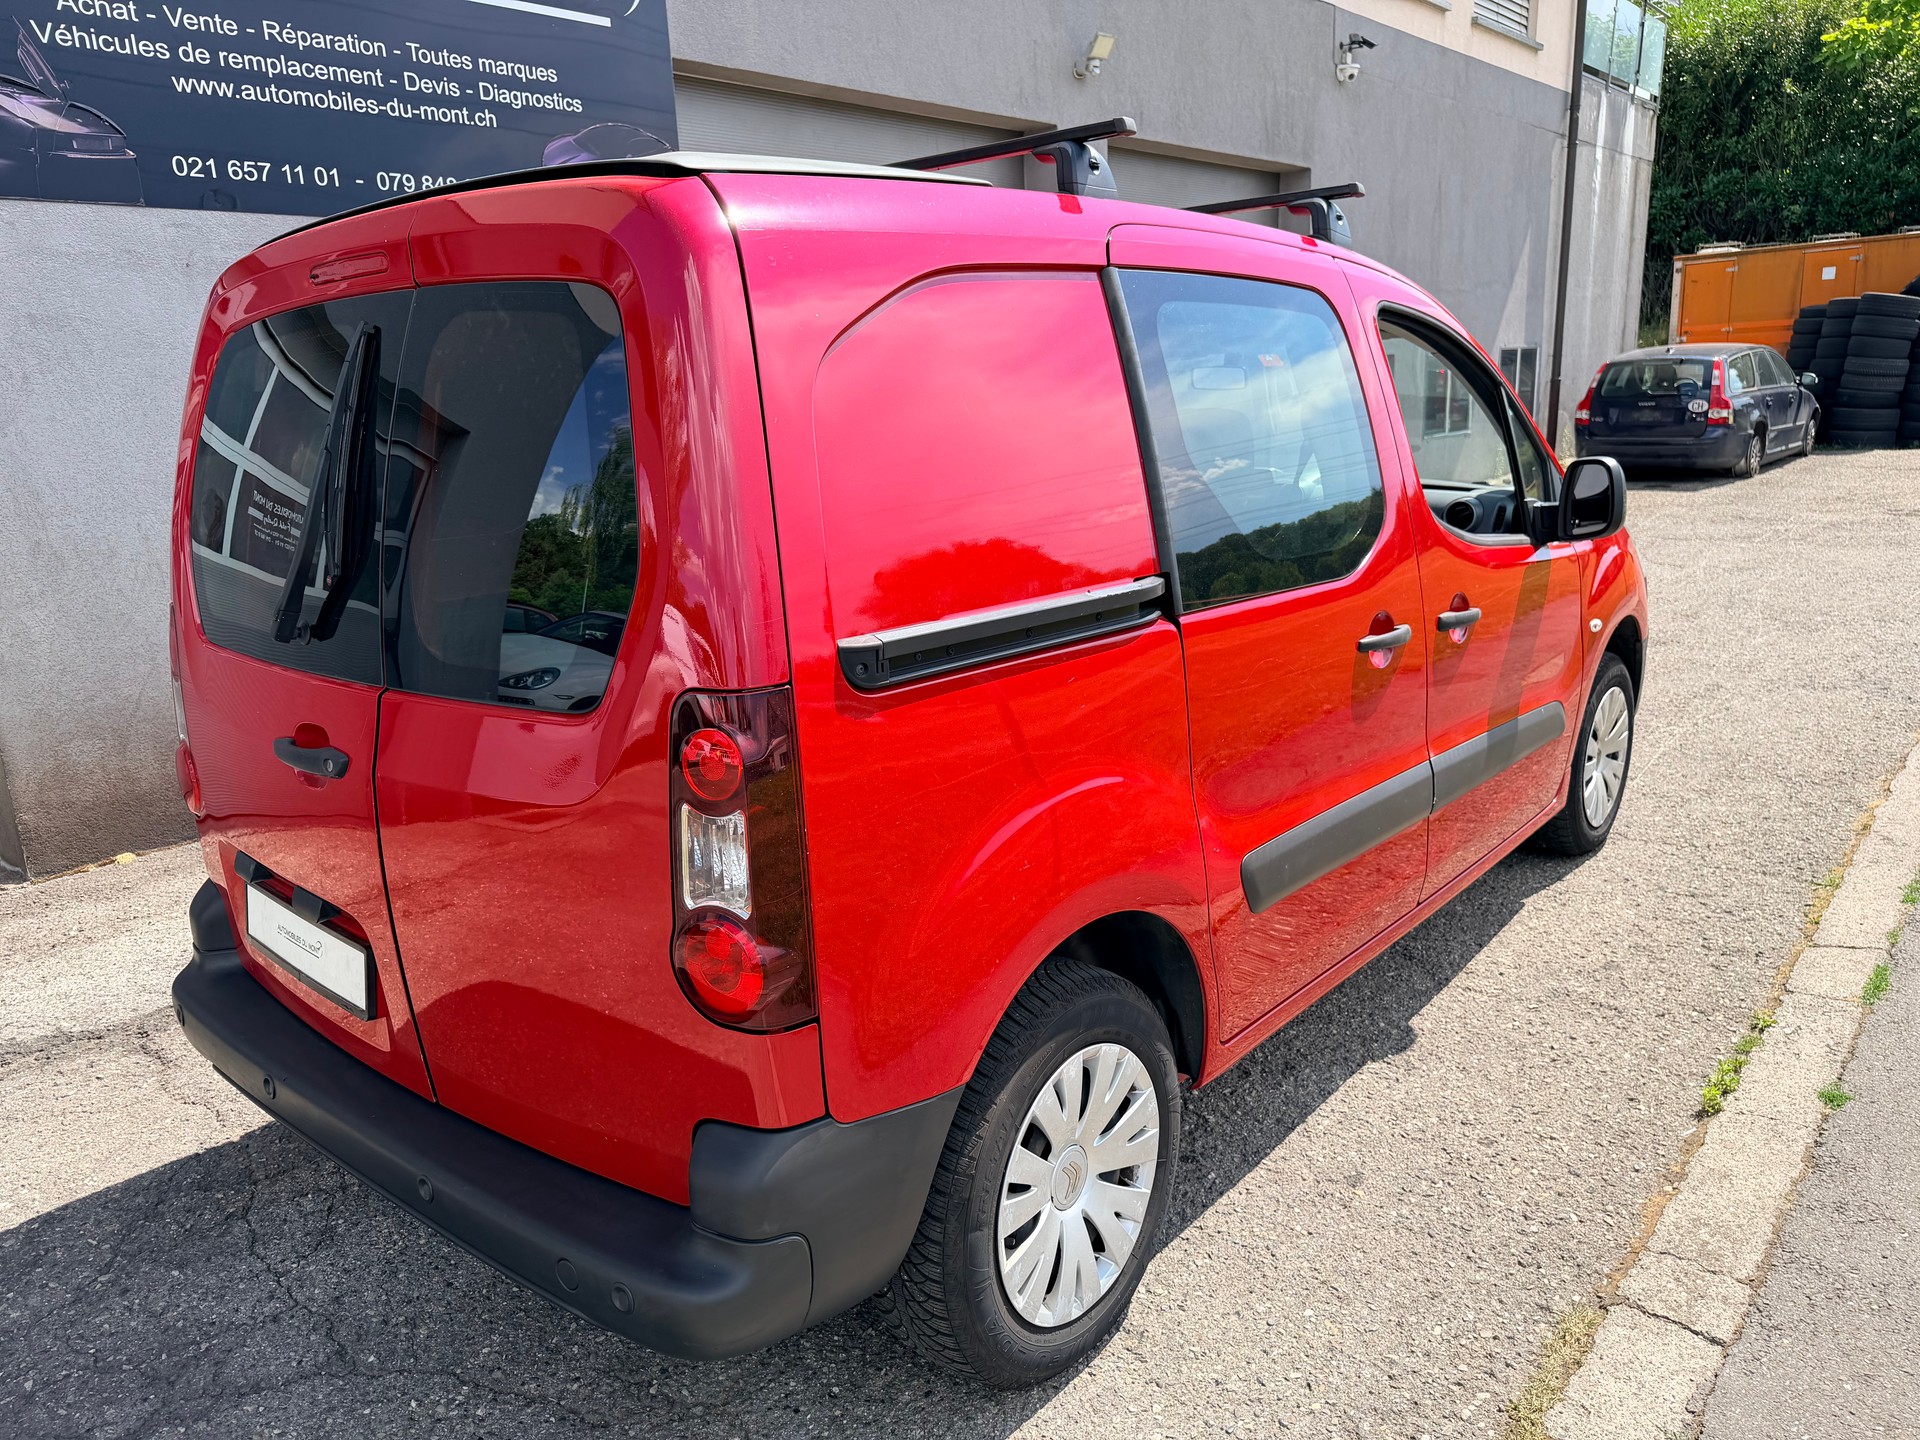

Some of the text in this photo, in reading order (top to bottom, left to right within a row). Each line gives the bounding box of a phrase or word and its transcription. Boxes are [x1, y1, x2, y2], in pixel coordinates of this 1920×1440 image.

[29, 19, 171, 60] Véhicules
[178, 41, 211, 65] de
[218, 51, 385, 88] remplacement
[403, 71, 461, 97] Devis
[478, 81, 583, 113] Diagnostics
[57, 0, 140, 22] Achat
[162, 4, 238, 36] Vente
[262, 19, 387, 58] Réparation
[405, 41, 473, 70] Toutes
[478, 57, 558, 83] marques
[170, 76, 498, 128] www.automobiles-du-mont.ch
[171, 155, 217, 179] 021
[227, 159, 271, 182] 657
[281, 163, 305, 185] 11
[313, 166, 340, 187] 01
[376, 171, 416, 193] 079
[1692, 401, 1704, 411] CH
